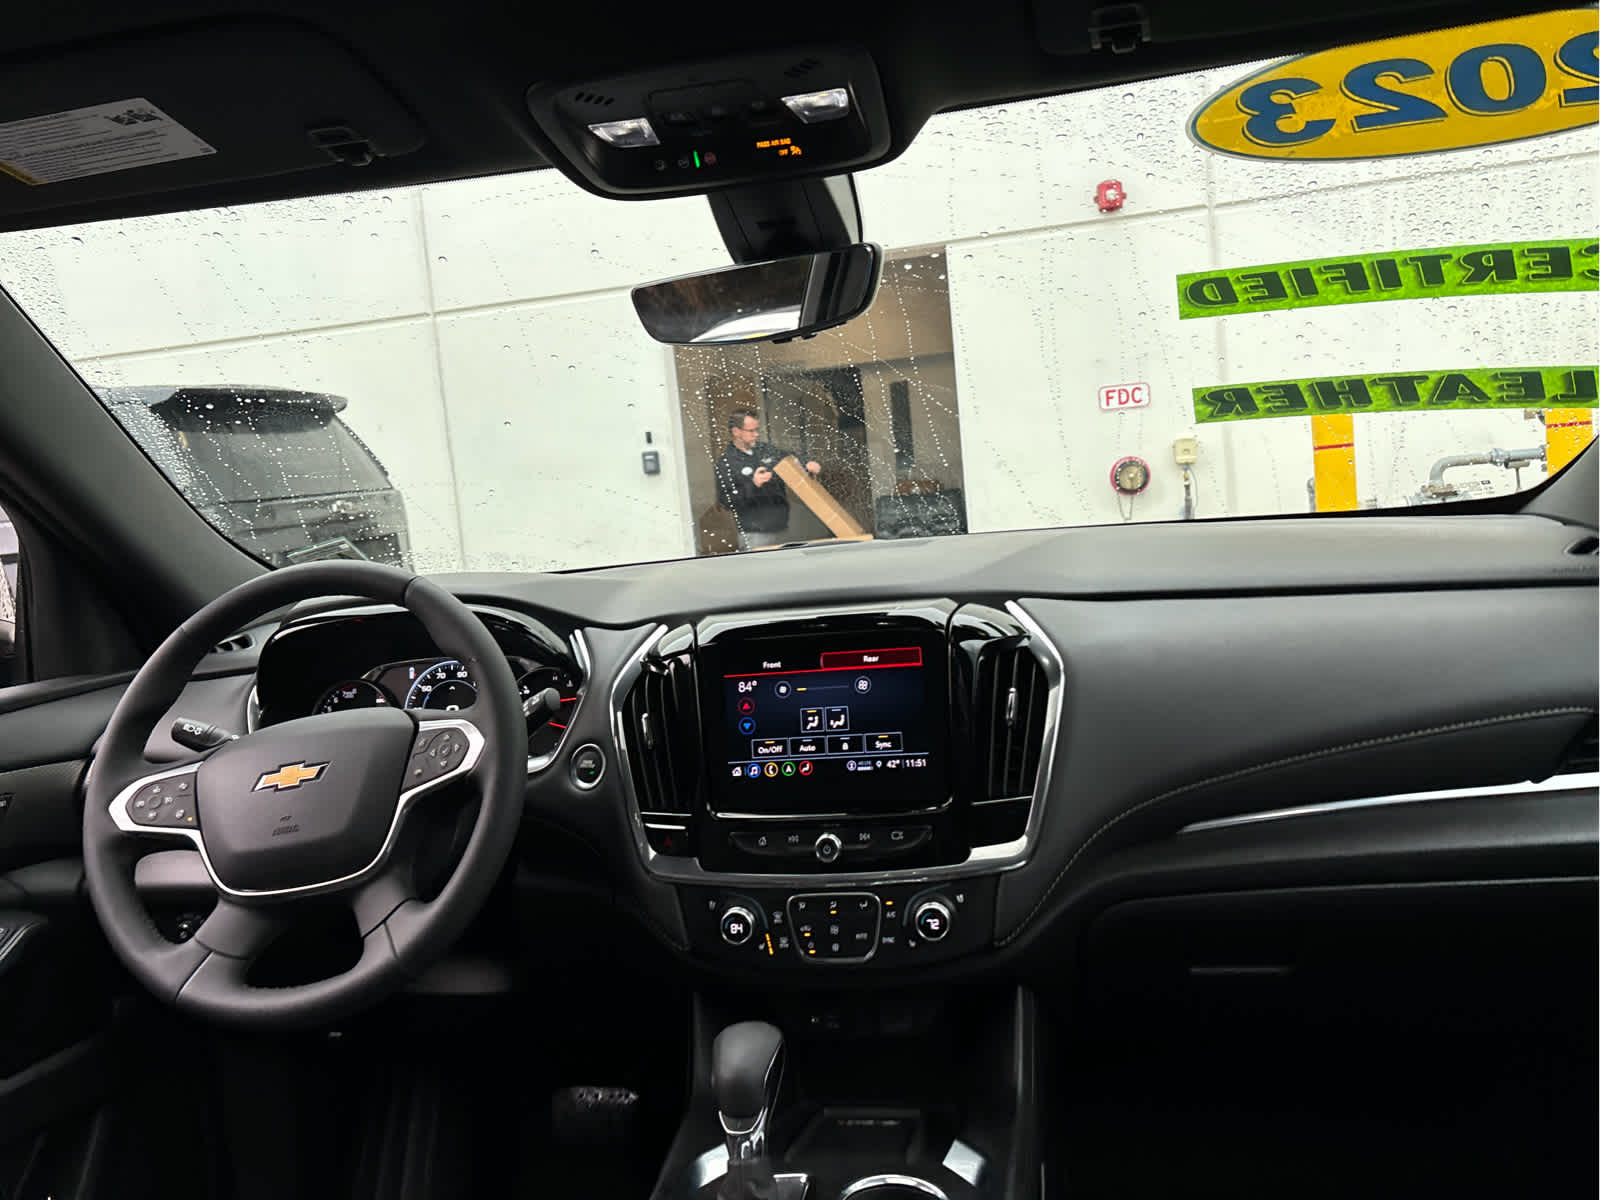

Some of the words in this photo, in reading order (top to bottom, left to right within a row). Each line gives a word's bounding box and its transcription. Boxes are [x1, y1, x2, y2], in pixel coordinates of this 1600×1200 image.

[1105, 387, 1142, 406] FDC
[863, 655, 879, 663] Rear
[763, 661, 782, 669] Front
[738, 680, 758, 693] 84°
[758, 745, 783, 755] On/Off
[799, 744, 816, 752] Auto
[875, 740, 892, 750] Sync
[905, 758, 927, 768] 11:51
[730, 923, 744, 935] 84
[925, 918, 940, 931] 72
